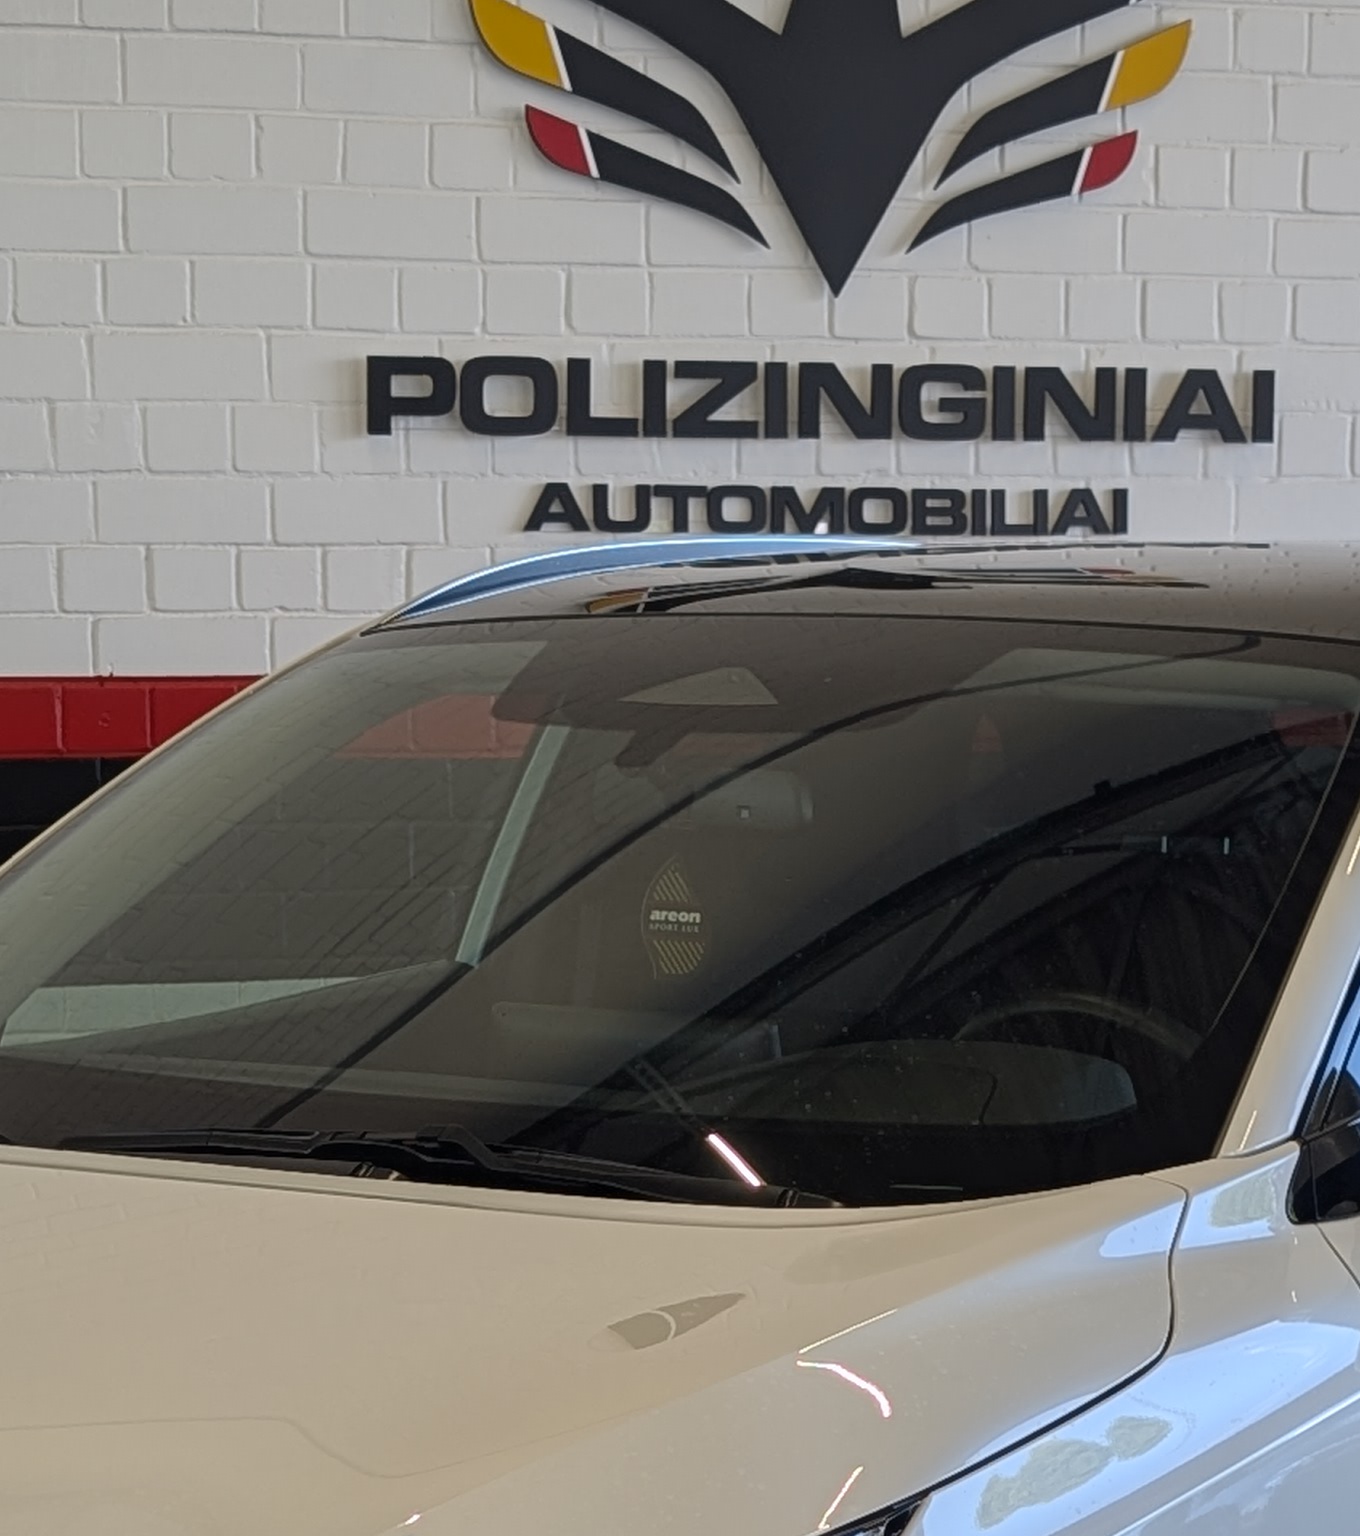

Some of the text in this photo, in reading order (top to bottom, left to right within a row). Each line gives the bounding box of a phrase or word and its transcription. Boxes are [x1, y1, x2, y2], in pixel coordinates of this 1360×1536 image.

[365, 354, 1276, 445] POLIZINGINIAI
[522, 481, 1129, 537] AUTOMOBILIAI
[649, 910, 701, 923] areon
